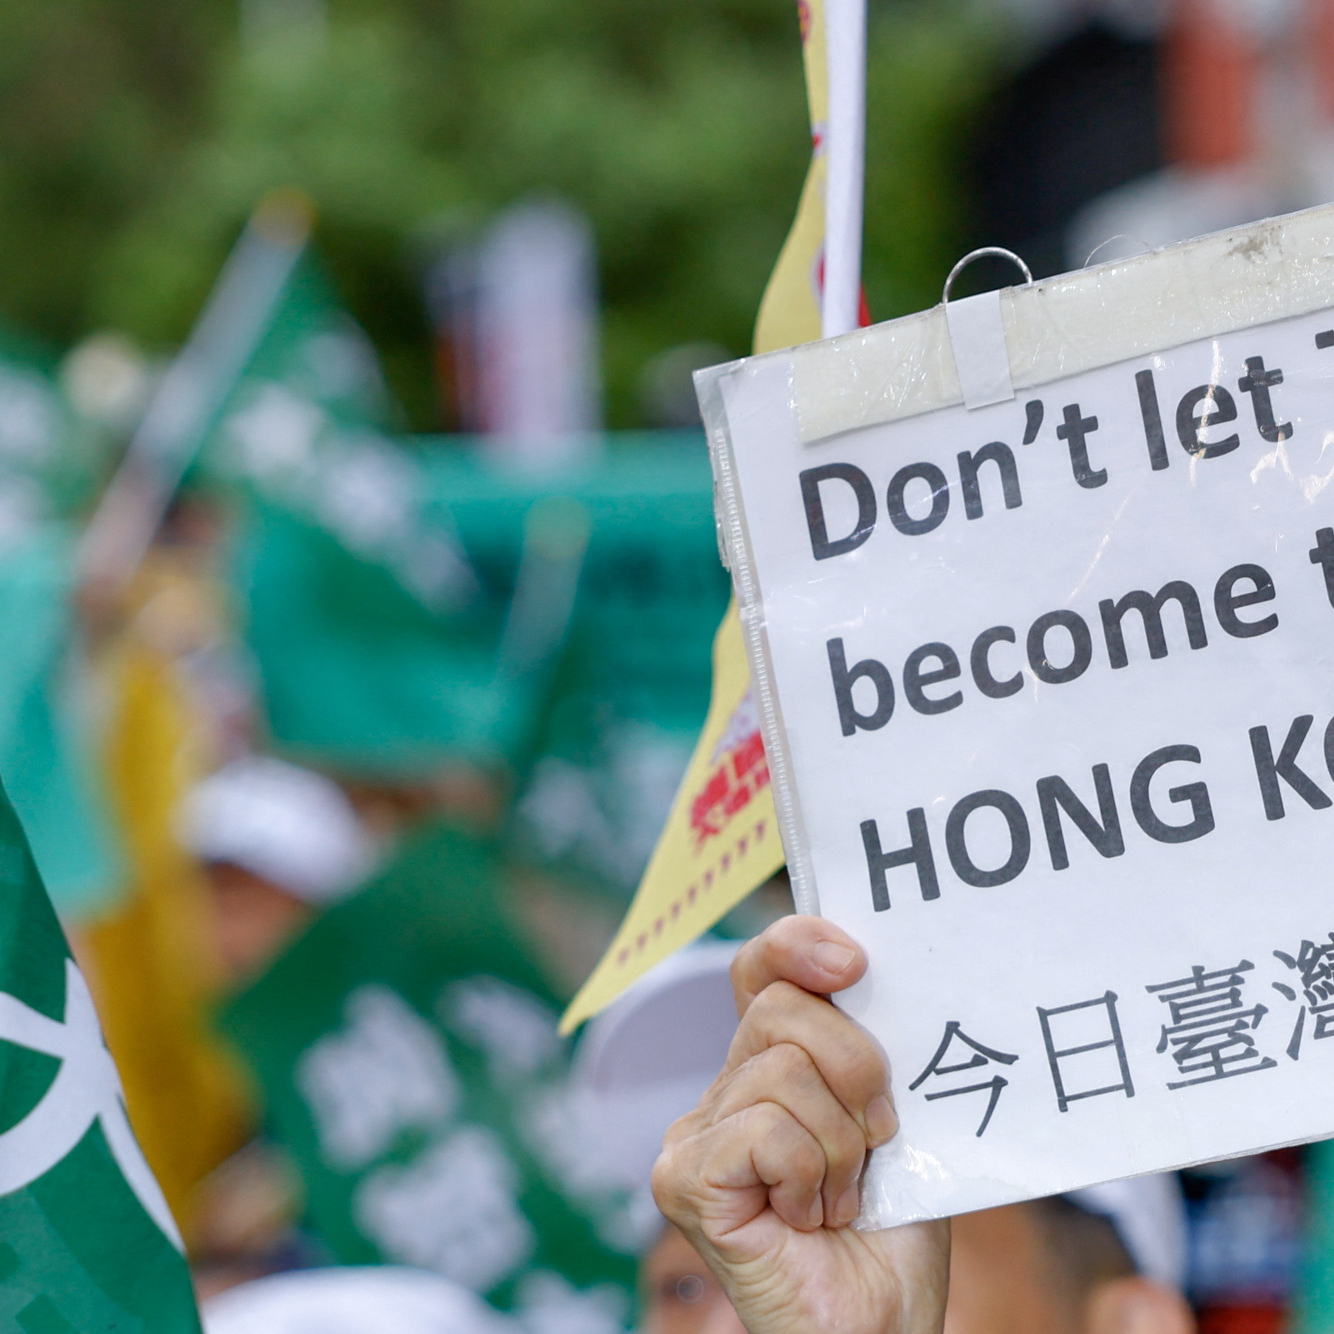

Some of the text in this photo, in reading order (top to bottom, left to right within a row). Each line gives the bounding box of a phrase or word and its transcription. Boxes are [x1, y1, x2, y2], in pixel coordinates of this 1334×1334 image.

[798, 399, 1109, 561] Don’t
[1135, 355, 1294, 473] let
[825, 562, 1280, 737] become
[859, 744, 1216, 913] HONG
